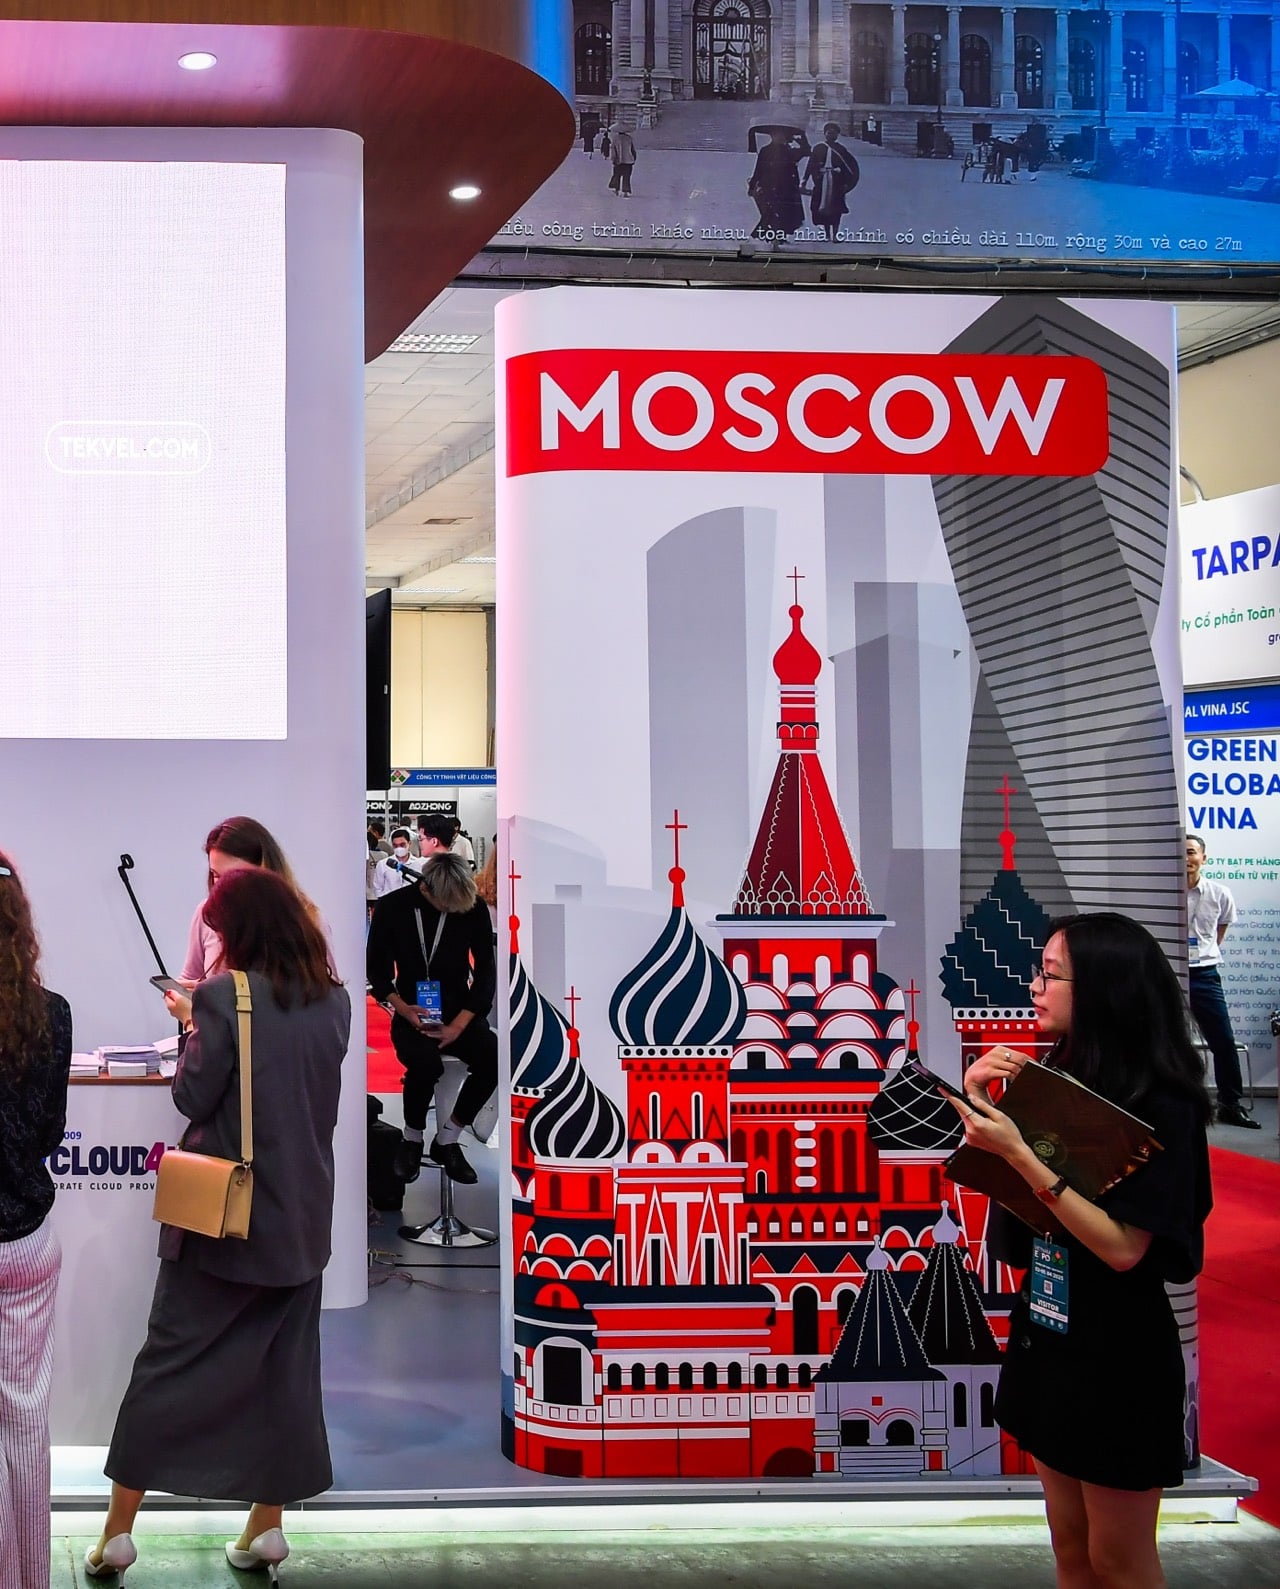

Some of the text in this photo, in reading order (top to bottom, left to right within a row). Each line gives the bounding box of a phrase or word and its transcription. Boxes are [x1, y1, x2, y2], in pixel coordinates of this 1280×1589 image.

[542, 220, 584, 241] công
[590, 221, 644, 239] trình
[649, 223, 694, 239] khác
[756, 224, 787, 241] tòa
[794, 225, 829, 242] nhà
[835, 227, 889, 244] chính
[895, 227, 915, 244] có
[921, 225, 972, 245] chiều
[978, 230, 1009, 247] dài
[1065, 232, 1108, 252] rộng
[1113, 234, 1143, 249] 30m
[1150, 234, 1172, 249] và
[1178, 239, 1208, 251] cao
[1214, 236, 1243, 252] 27m
[540, 370, 1066, 457] MOSCOW
[59, 436, 199, 460] TEKVEL.COM
[1247, 606, 1275, 622] Toàn
[1184, 701, 1250, 719] AL VINA JSC
[1187, 738, 1277, 762] GREEN
[1187, 772, 1280, 797] GLOBA
[1187, 806, 1259, 830] VINA
[1216, 857, 1225, 866] TY
[1245, 857, 1255, 866] PE
[50, 1142, 176, 1177] CLOUD4
[90, 1182, 123, 1191] CLOUD
[130, 1182, 155, 1191] PROV
[1037, 1298, 1060, 1313] VISITOR
